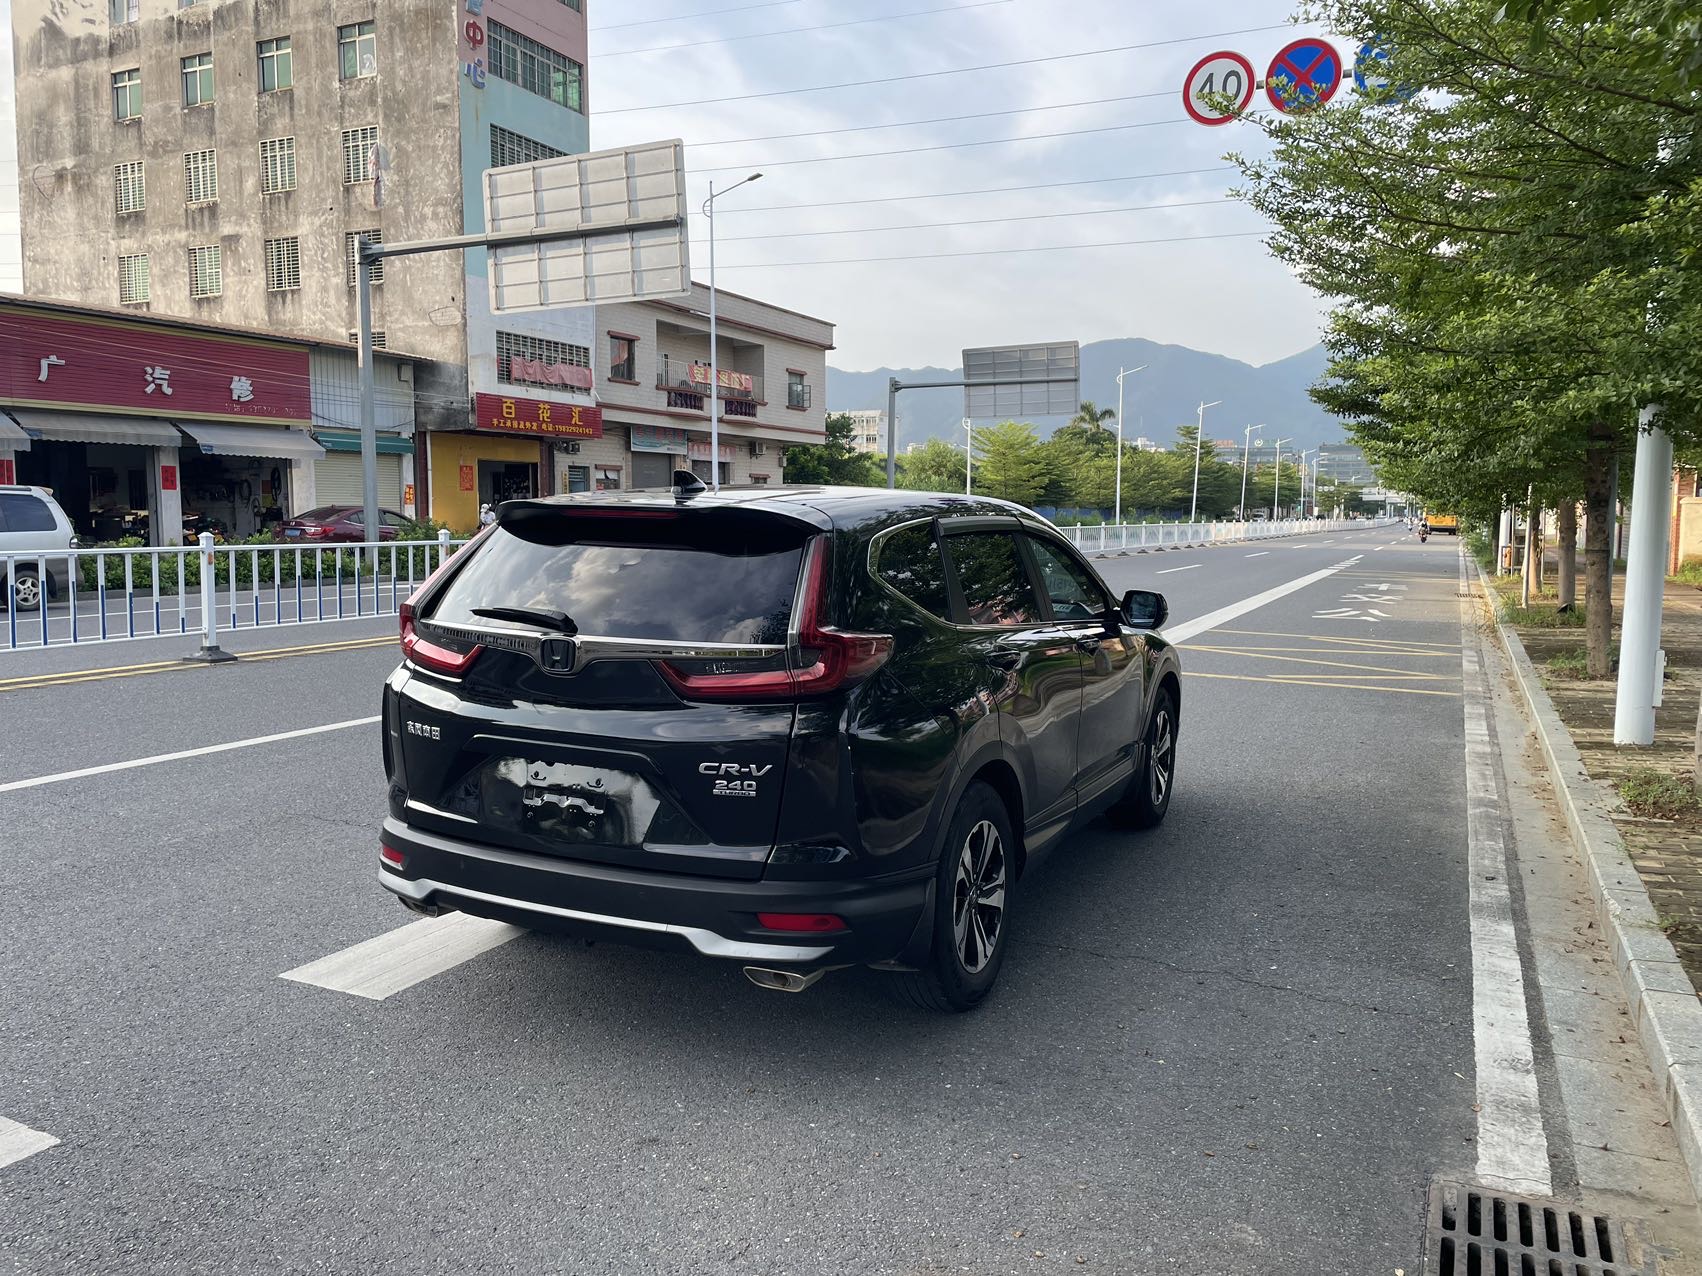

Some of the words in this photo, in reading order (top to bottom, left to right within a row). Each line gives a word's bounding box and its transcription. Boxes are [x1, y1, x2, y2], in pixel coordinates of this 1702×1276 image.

[1198, 69, 1242, 100] 40
[502, 399, 584, 425] 百花汇
[698, 761, 773, 776] CR-V
[714, 780, 757, 791] 240
